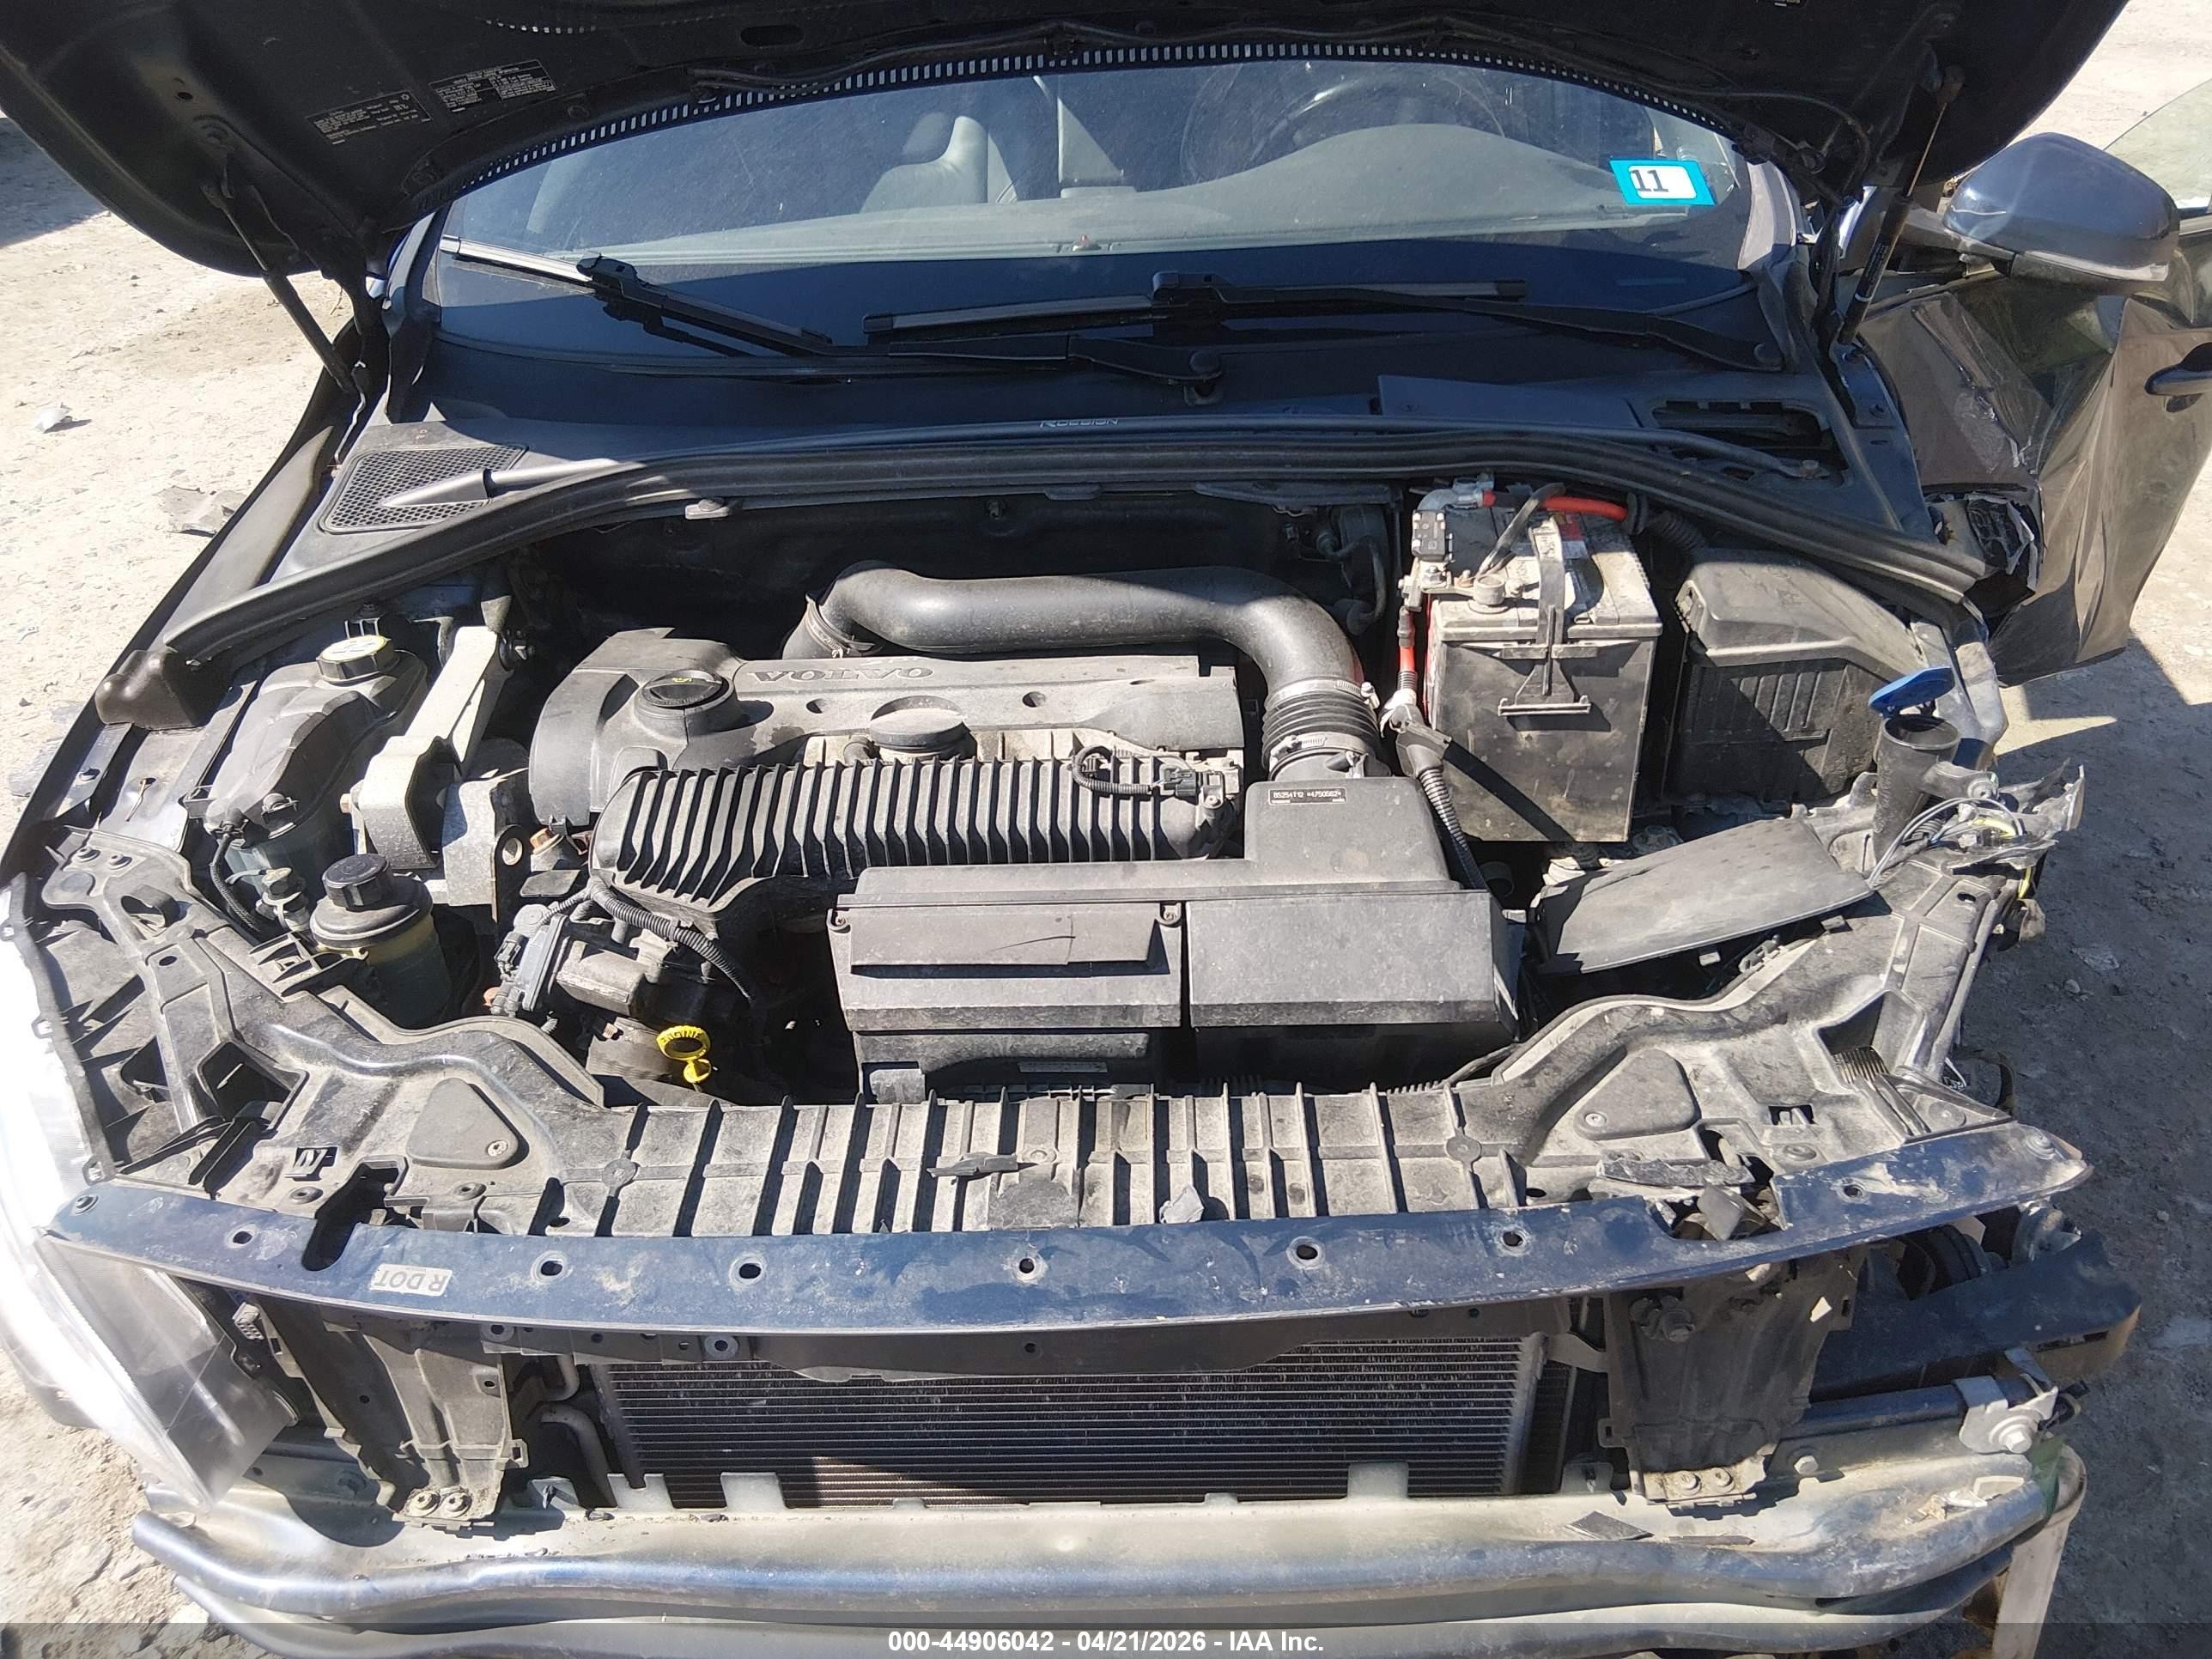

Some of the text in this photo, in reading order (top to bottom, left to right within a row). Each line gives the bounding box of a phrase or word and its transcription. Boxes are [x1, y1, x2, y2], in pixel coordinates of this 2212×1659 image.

[1632, 169, 1668, 192] 11
[748, 667, 934, 684] VOLVO
[374, 1271, 447, 1292] R DOT
